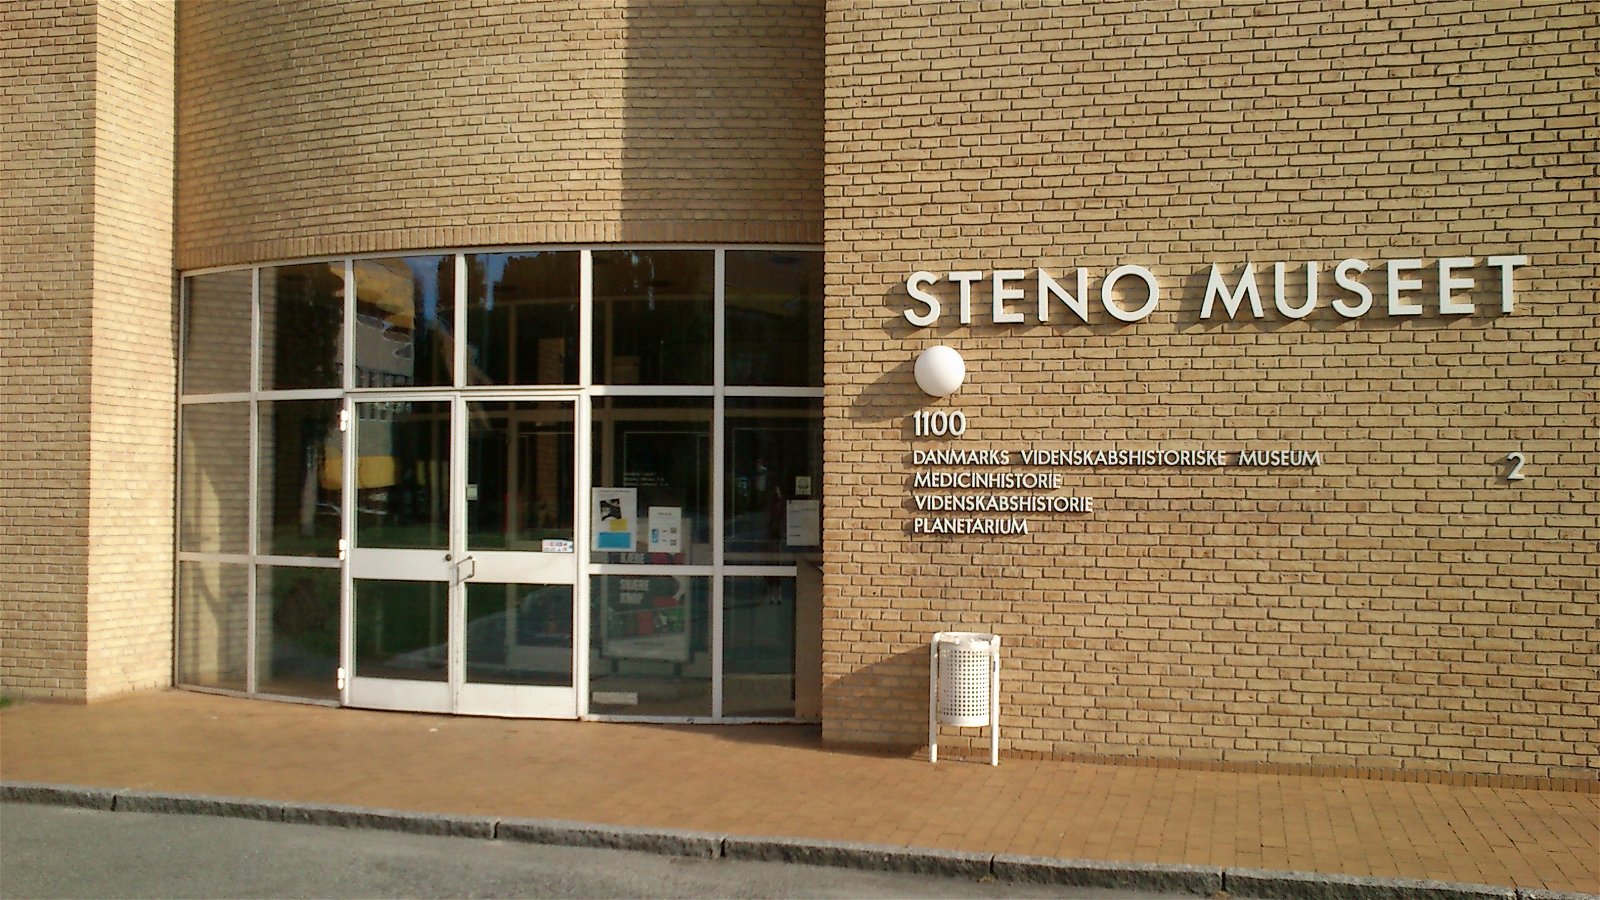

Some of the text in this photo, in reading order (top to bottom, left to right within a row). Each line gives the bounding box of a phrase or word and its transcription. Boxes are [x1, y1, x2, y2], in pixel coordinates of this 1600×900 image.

[903, 255, 1528, 326] STENO MUSEET
[913, 410, 966, 436] 1100
[913, 449, 1322, 467] DANMARKS VIDENSKABSHISTORISKE MUSEUM
[1508, 452, 1526, 480] 2
[913, 472, 1062, 489] MEDICINHISTORIE
[914, 495, 1094, 513] VIDENSKABSHISTORIE
[914, 518, 1029, 535] PLANETARIUM
